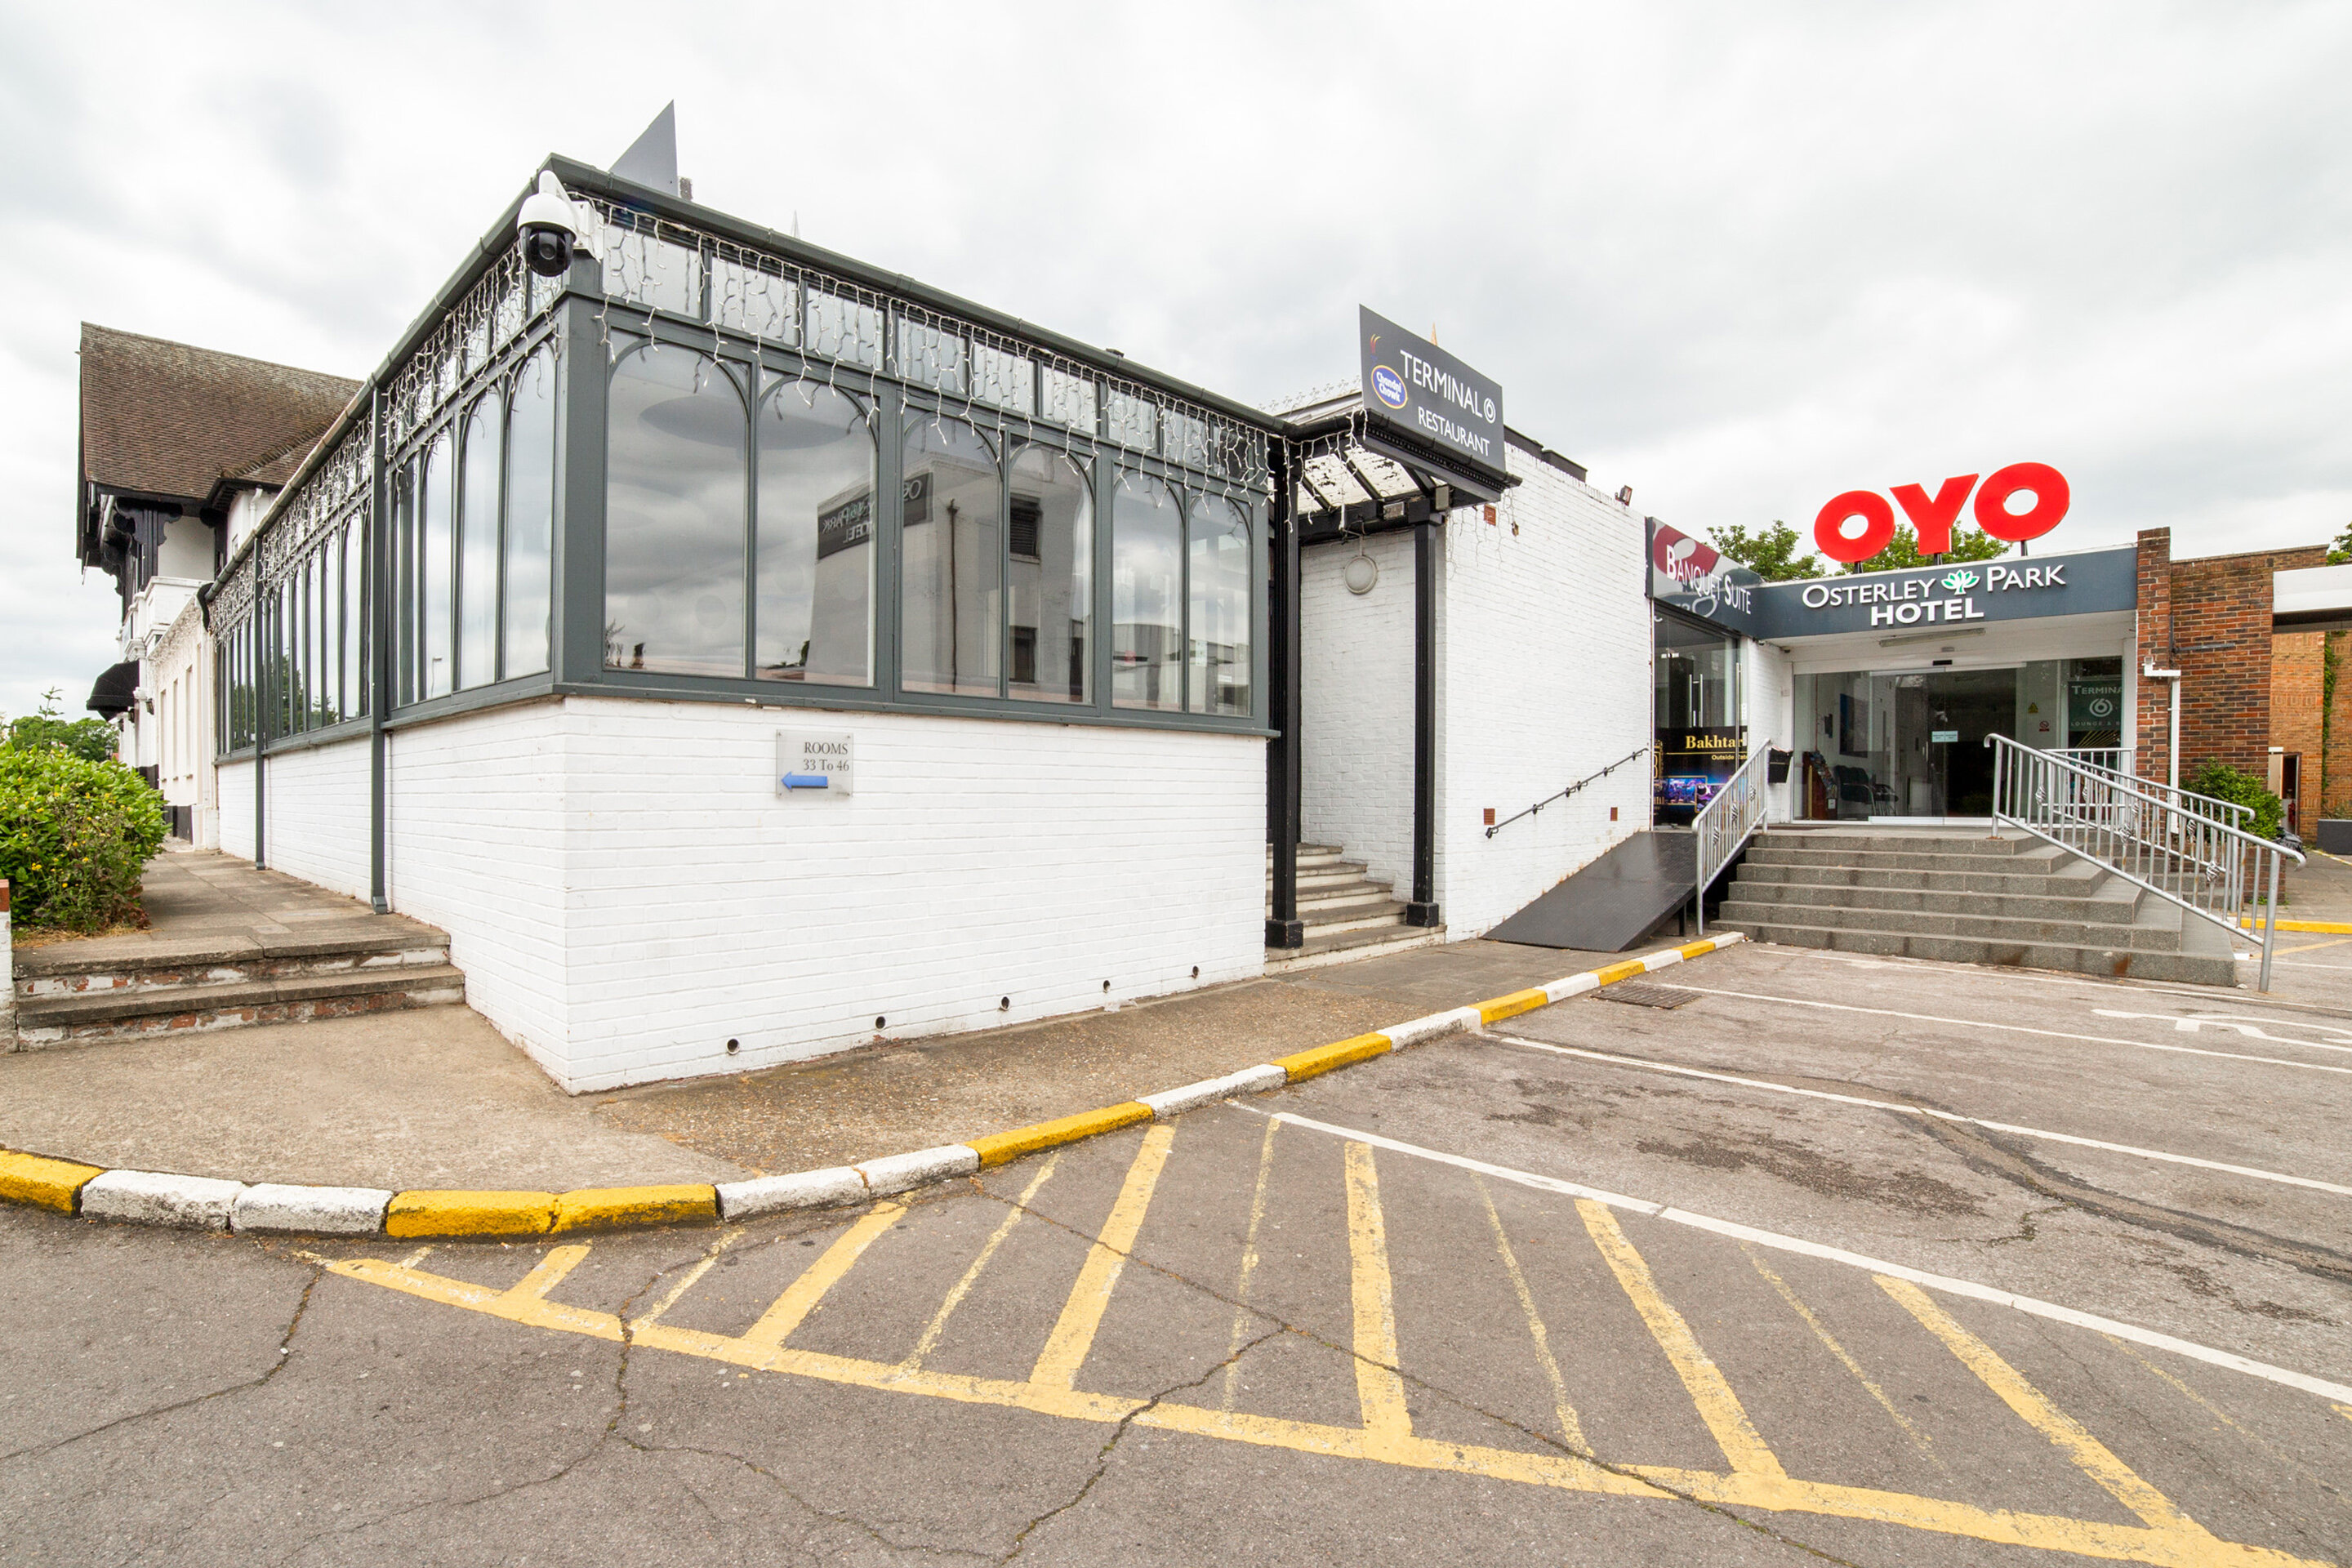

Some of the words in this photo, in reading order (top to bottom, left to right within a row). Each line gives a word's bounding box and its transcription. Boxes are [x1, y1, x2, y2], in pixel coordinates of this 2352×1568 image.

[1376, 372, 1401, 393] Chandni
[1379, 382, 1401, 403] Chowk
[1400, 350, 1482, 418] TERMINAL
[1418, 406, 1490, 457] RESTAURANT
[1814, 461, 2070, 564] OYO
[1667, 544, 1722, 601] BANQUET
[1724, 574, 1751, 615] SUITE
[1802, 578, 1936, 608] OSTERLEY
[1986, 564, 2067, 593] PARK
[1871, 597, 1984, 626] HOTEL
[803, 759, 816, 771] 33
[819, 759, 834, 771] To
[836, 760, 850, 772] 46
[804, 742, 849, 755] ROOMS
